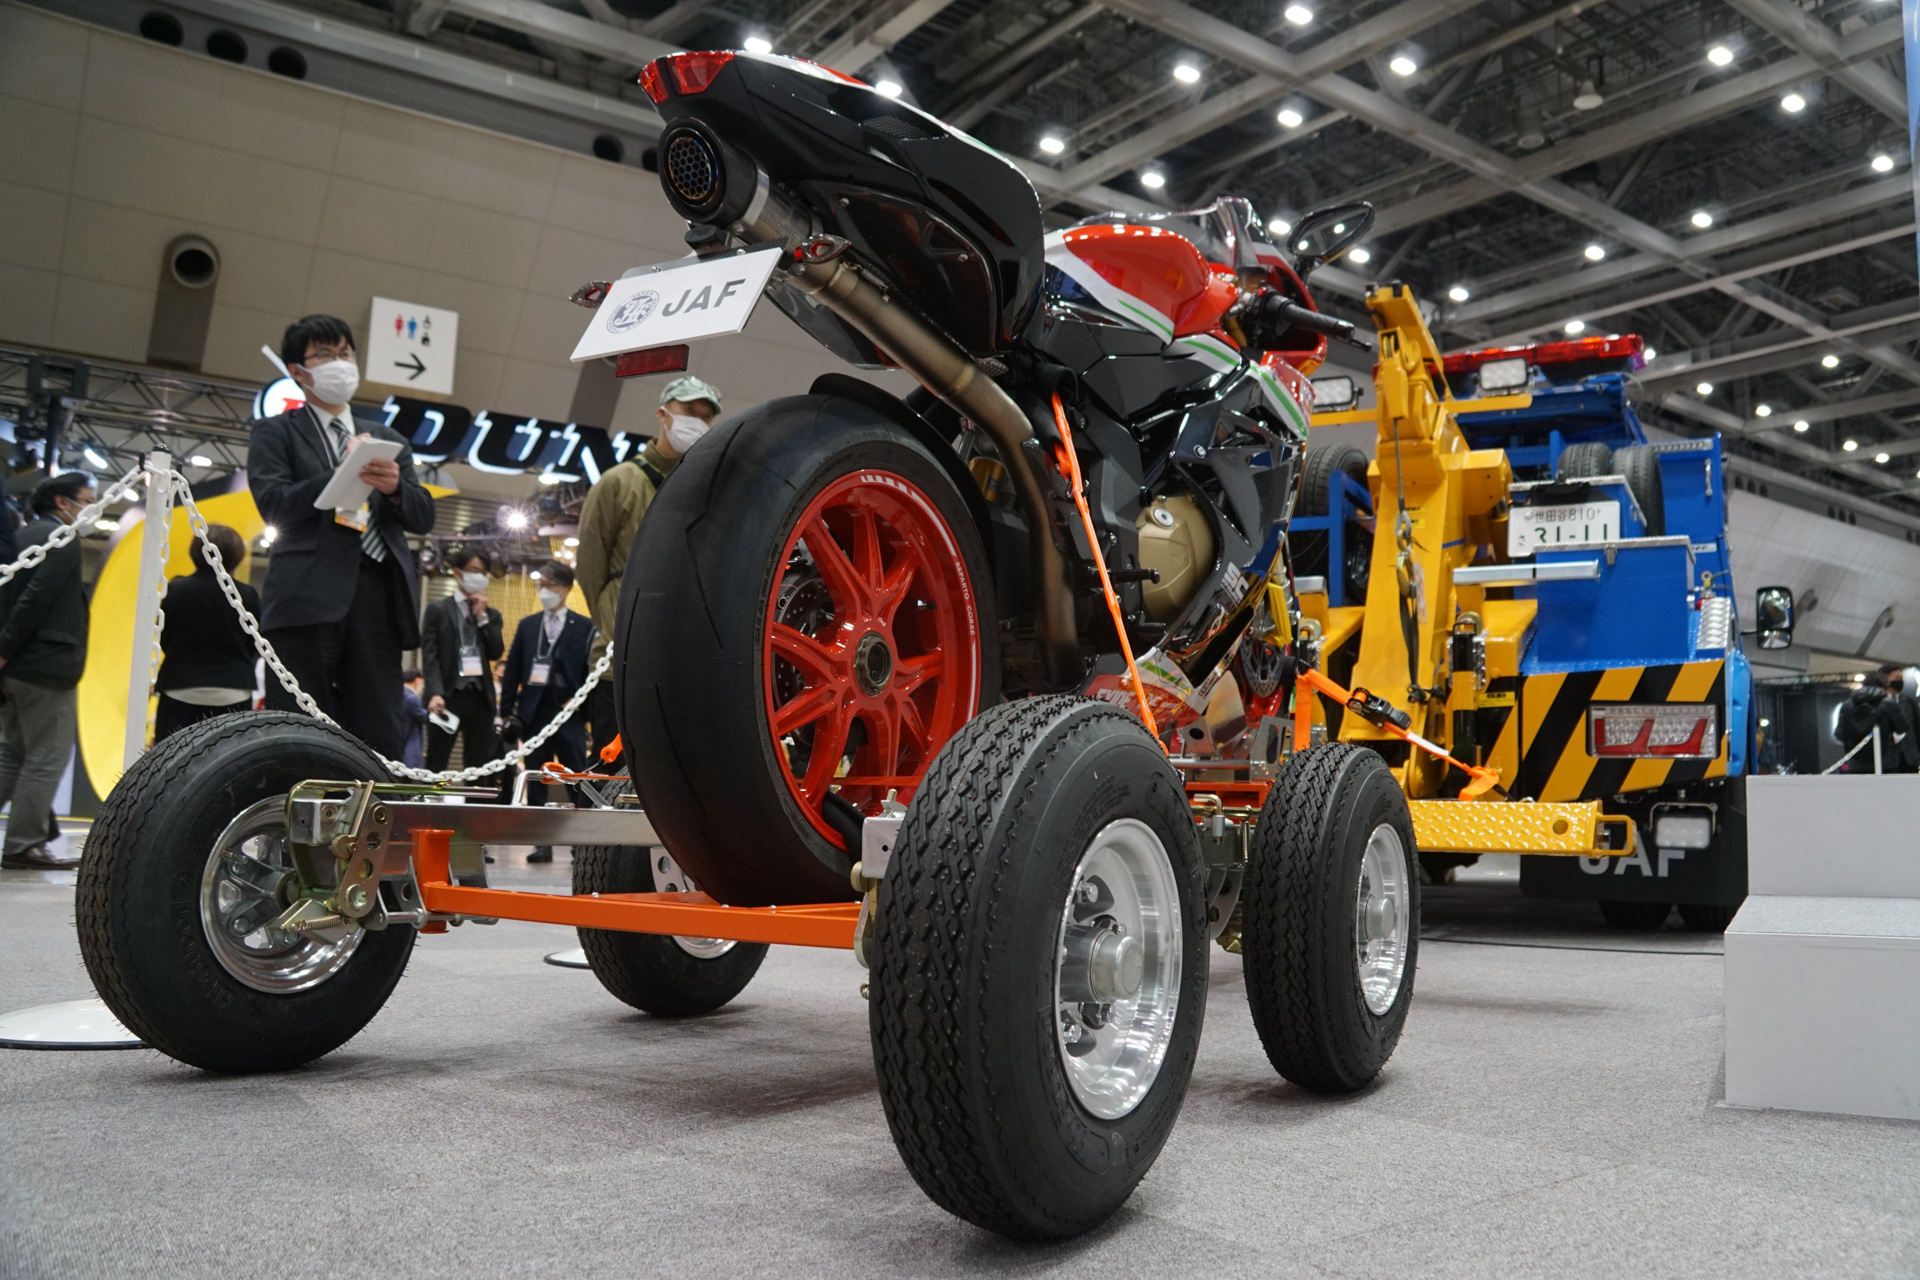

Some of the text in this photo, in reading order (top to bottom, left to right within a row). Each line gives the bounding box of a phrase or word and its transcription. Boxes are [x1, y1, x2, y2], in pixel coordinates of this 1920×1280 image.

[661, 278, 746, 317] JAF
[955, 561, 976, 636] REPARTO CORSE
